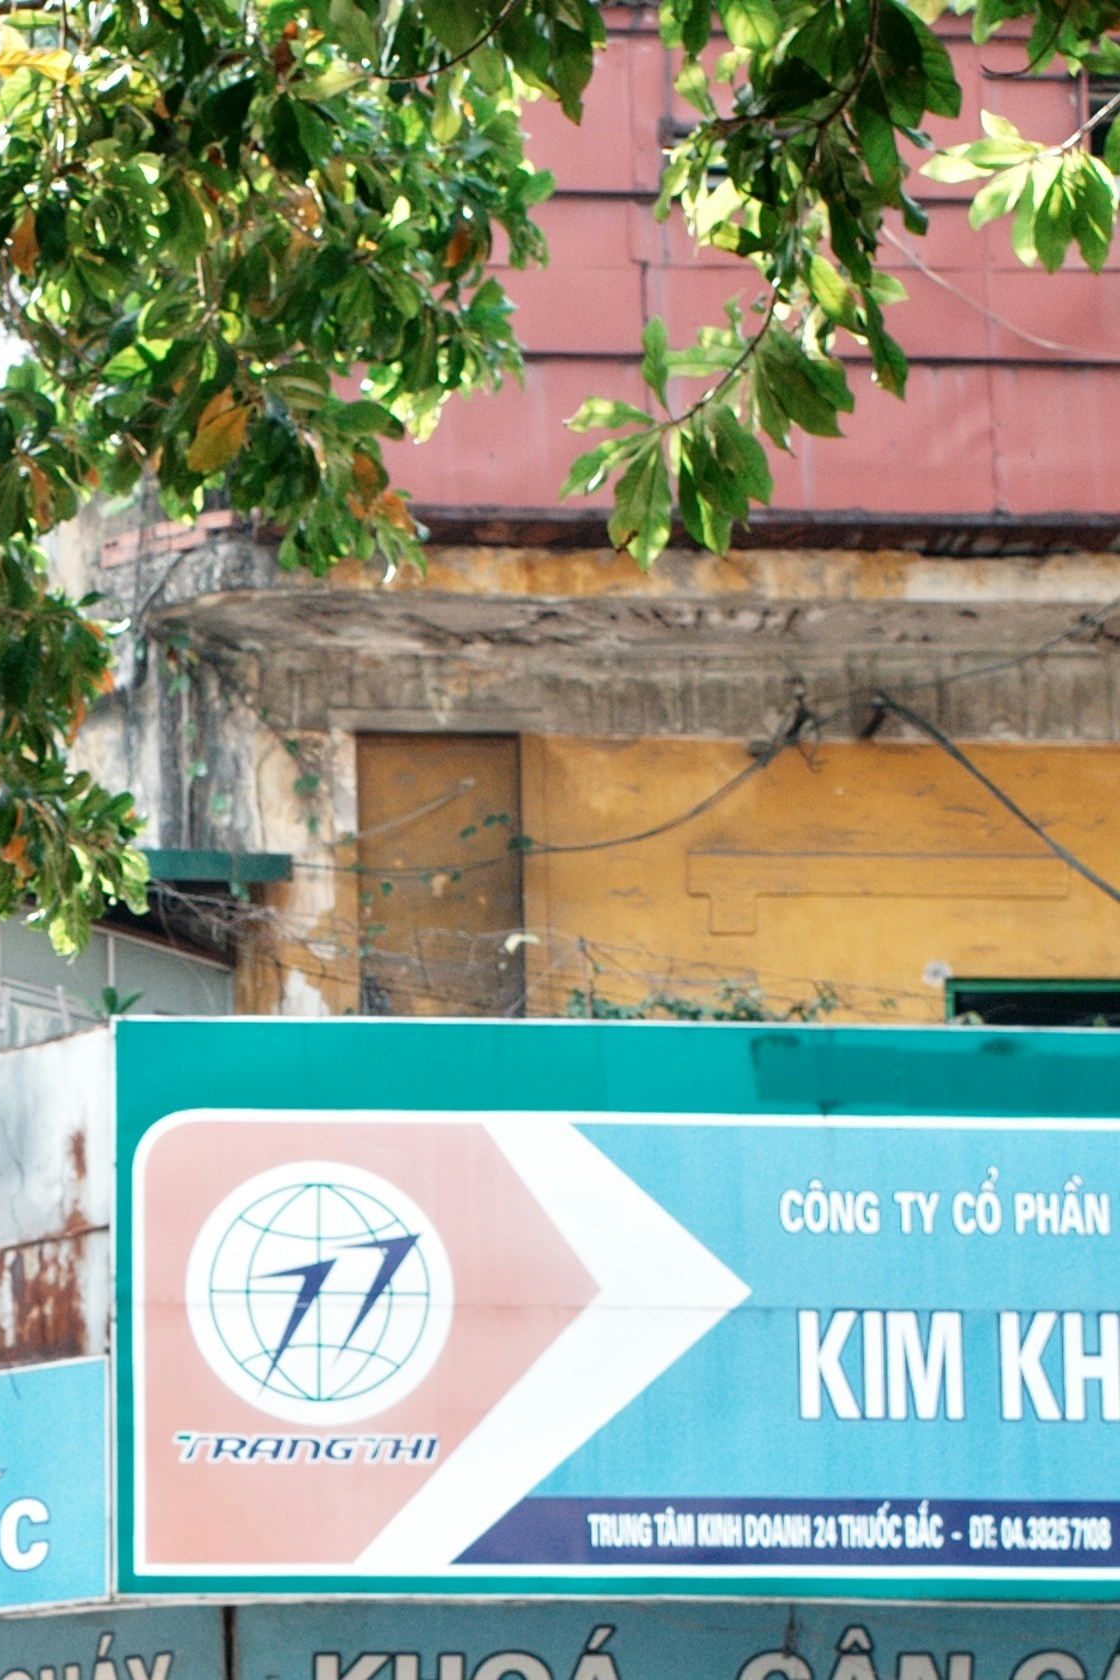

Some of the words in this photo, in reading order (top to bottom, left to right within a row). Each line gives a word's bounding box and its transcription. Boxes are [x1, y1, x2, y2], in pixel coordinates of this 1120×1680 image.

[779, 1178, 881, 1235] CÔNG
[892, 1191, 940, 1235] TY
[951, 1165, 1003, 1236] CỔ
[1013, 1173, 1111, 1236] PHẦN
[797, 1309, 965, 1421] KIM
[997, 1310, 1120, 1423] KH
[587, 1512, 653, 1548] TRUNG
[653, 1505, 695, 1548] TÂM
[697, 1513, 742, 1548] KINH
[744, 1513, 812, 1549] DOANH
[813, 1515, 838, 1549] 24
[837, 1500, 902, 1550] THUỐC
[904, 1499, 944, 1550] BẮC
